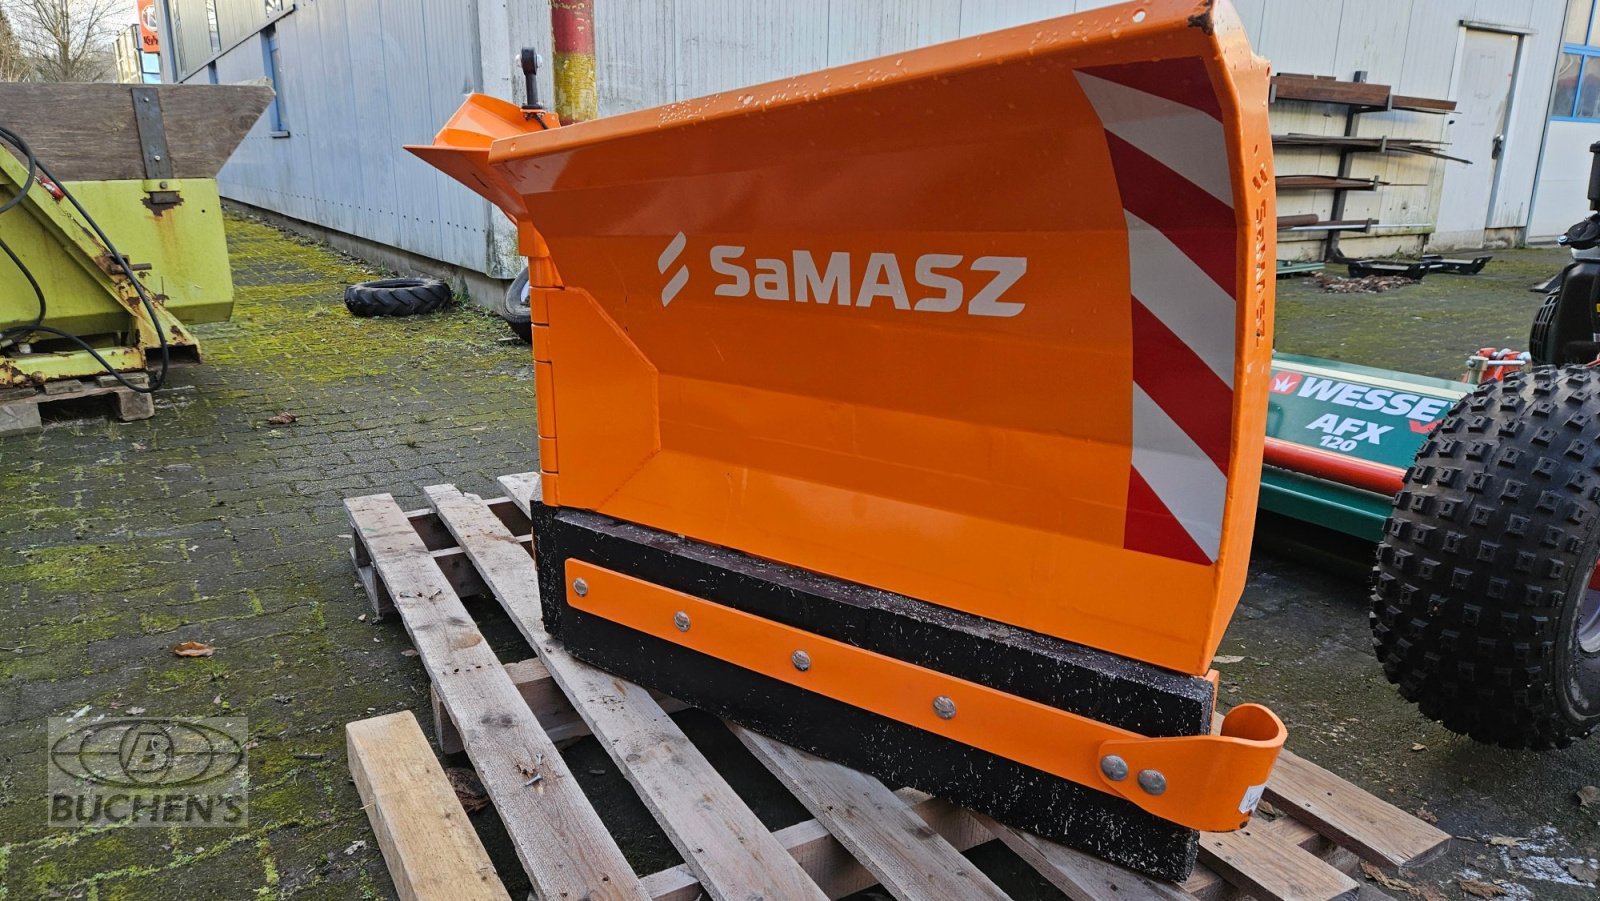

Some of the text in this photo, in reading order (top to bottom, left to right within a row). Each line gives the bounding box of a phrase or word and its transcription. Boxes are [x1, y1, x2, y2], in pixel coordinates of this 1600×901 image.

[709, 245, 1028, 317] SaMASZ
[1297, 376, 1457, 422] WESSE
[1305, 413, 1395, 445] AFX
[1320, 435, 1358, 452] 120
